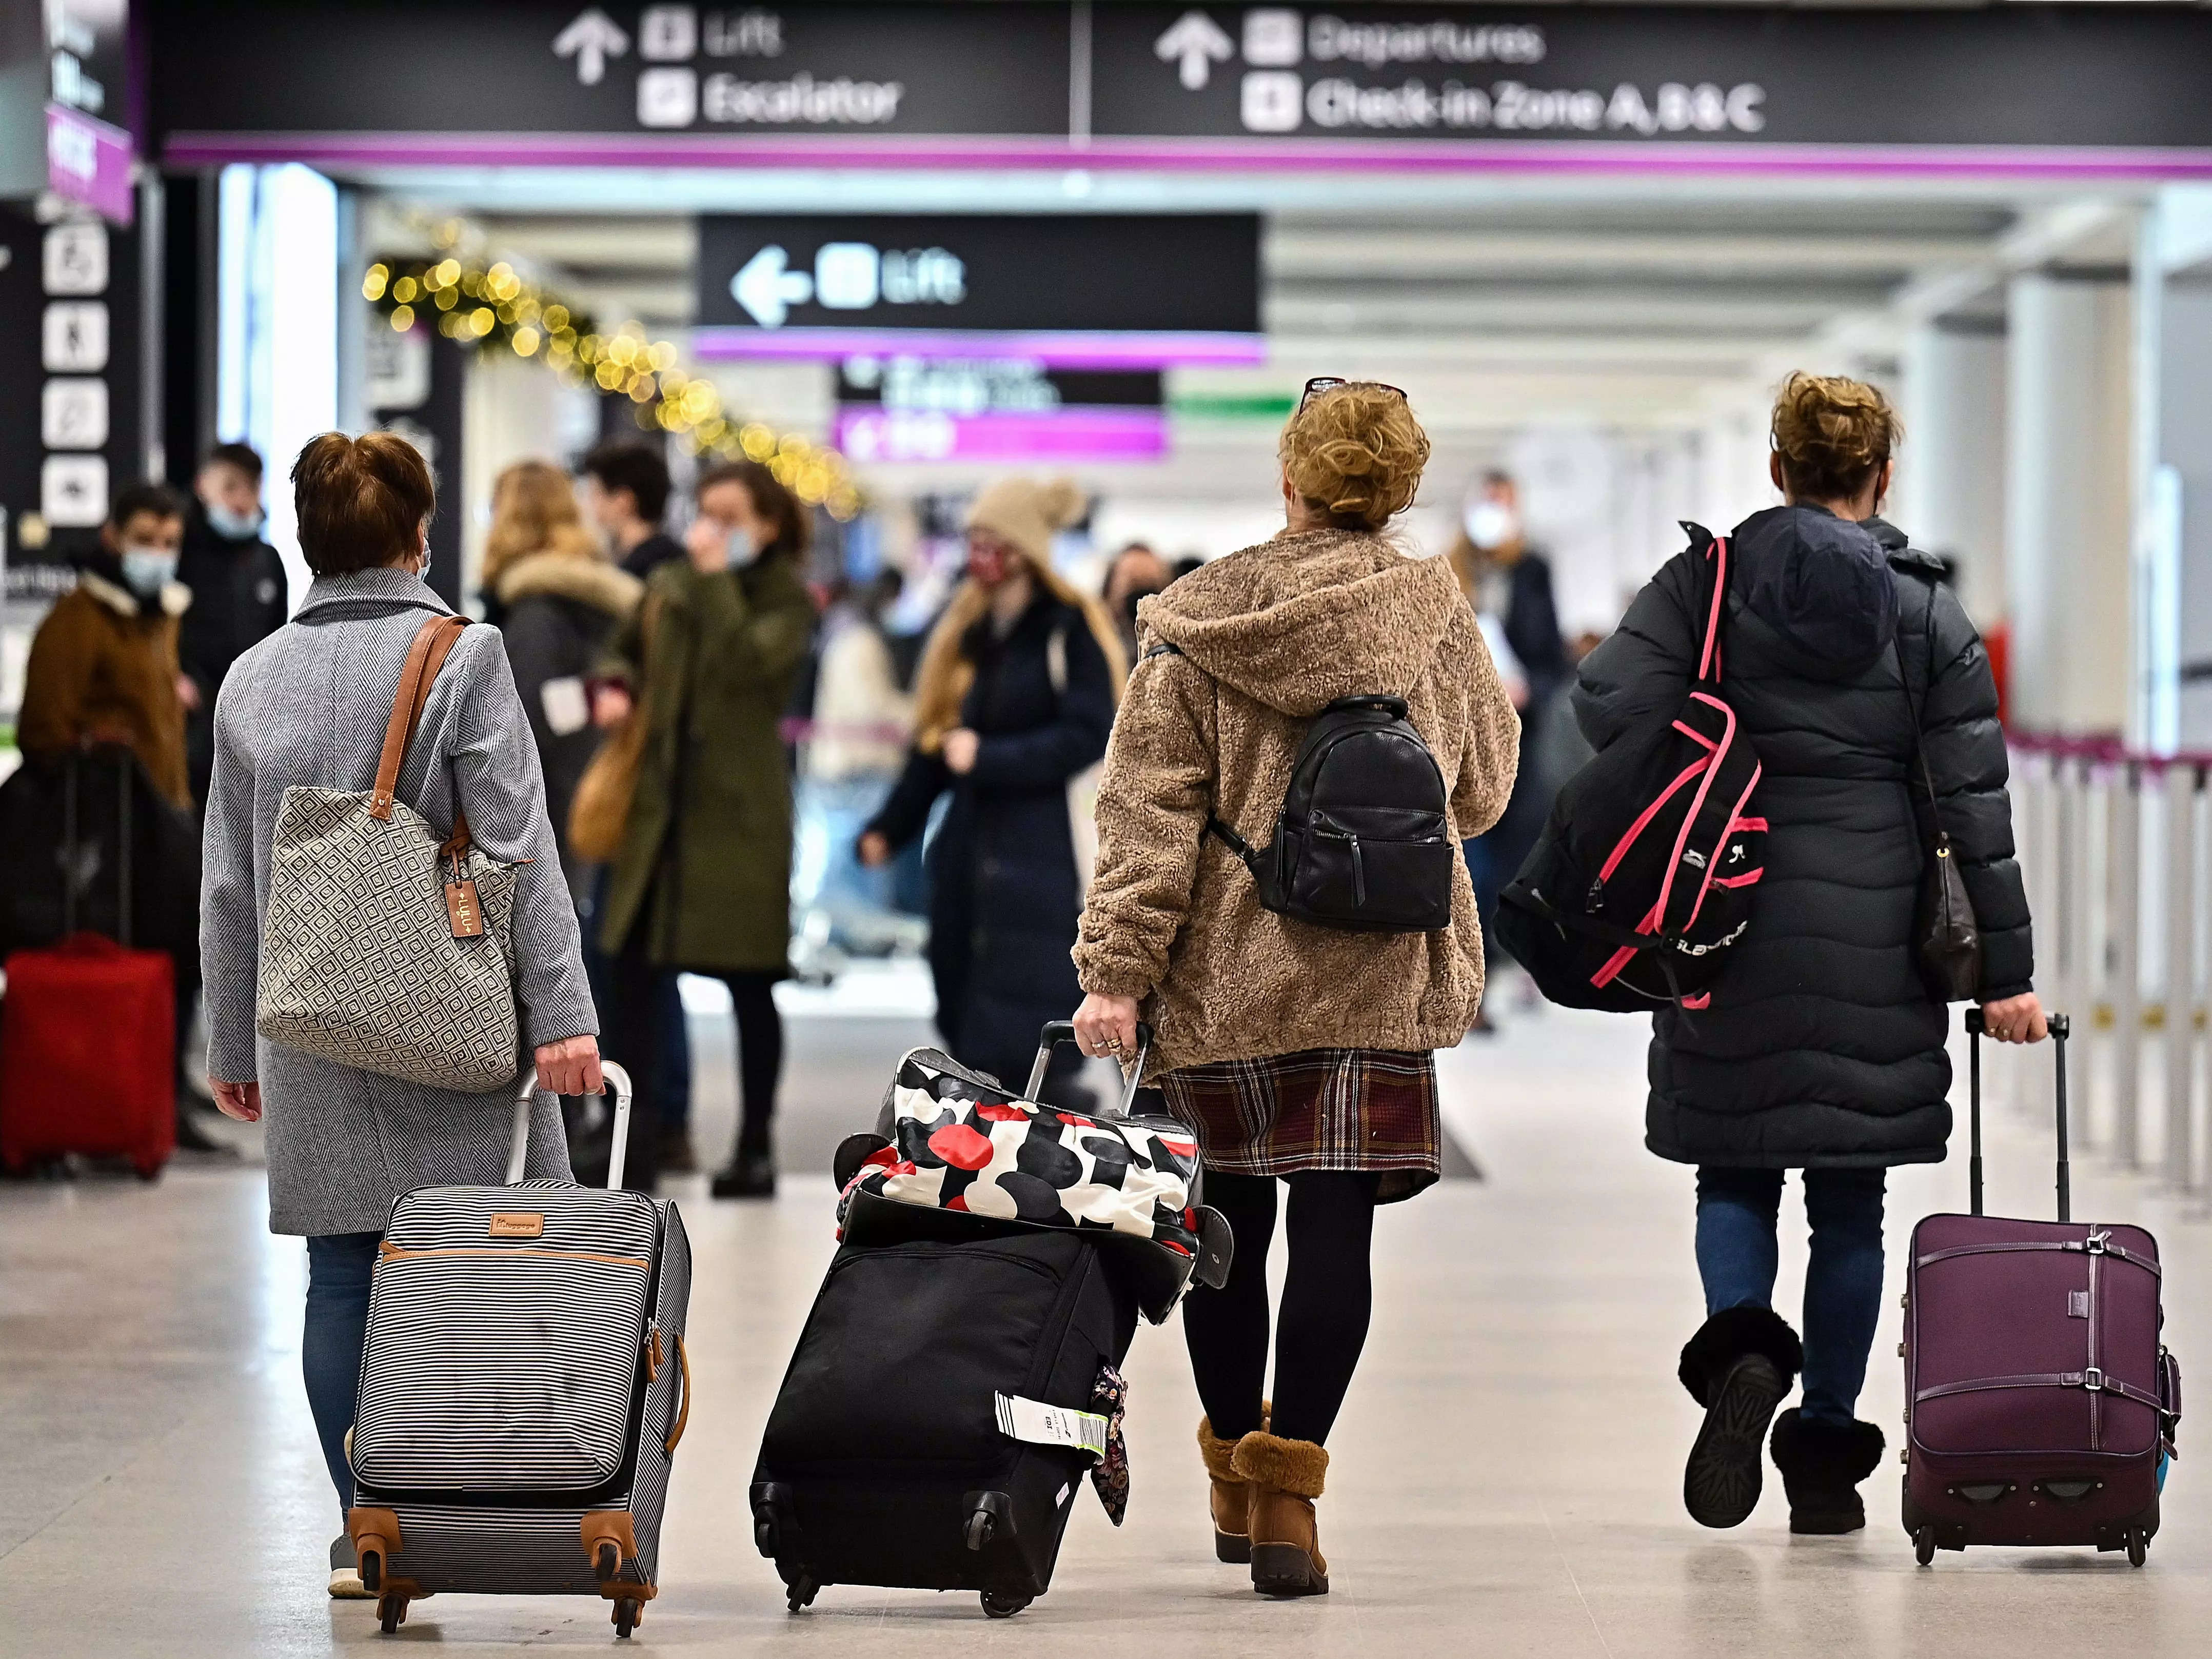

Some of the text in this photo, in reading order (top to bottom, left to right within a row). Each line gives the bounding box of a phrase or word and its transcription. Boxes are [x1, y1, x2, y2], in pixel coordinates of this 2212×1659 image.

[704, 11, 784, 57] Lift
[1308, 14, 1546, 69] Departures
[702, 72, 904, 124] Escalator
[1491, 80, 1606, 130] Zone
[882, 246, 967, 306] Lift
[458, 899, 472, 926] LULU
